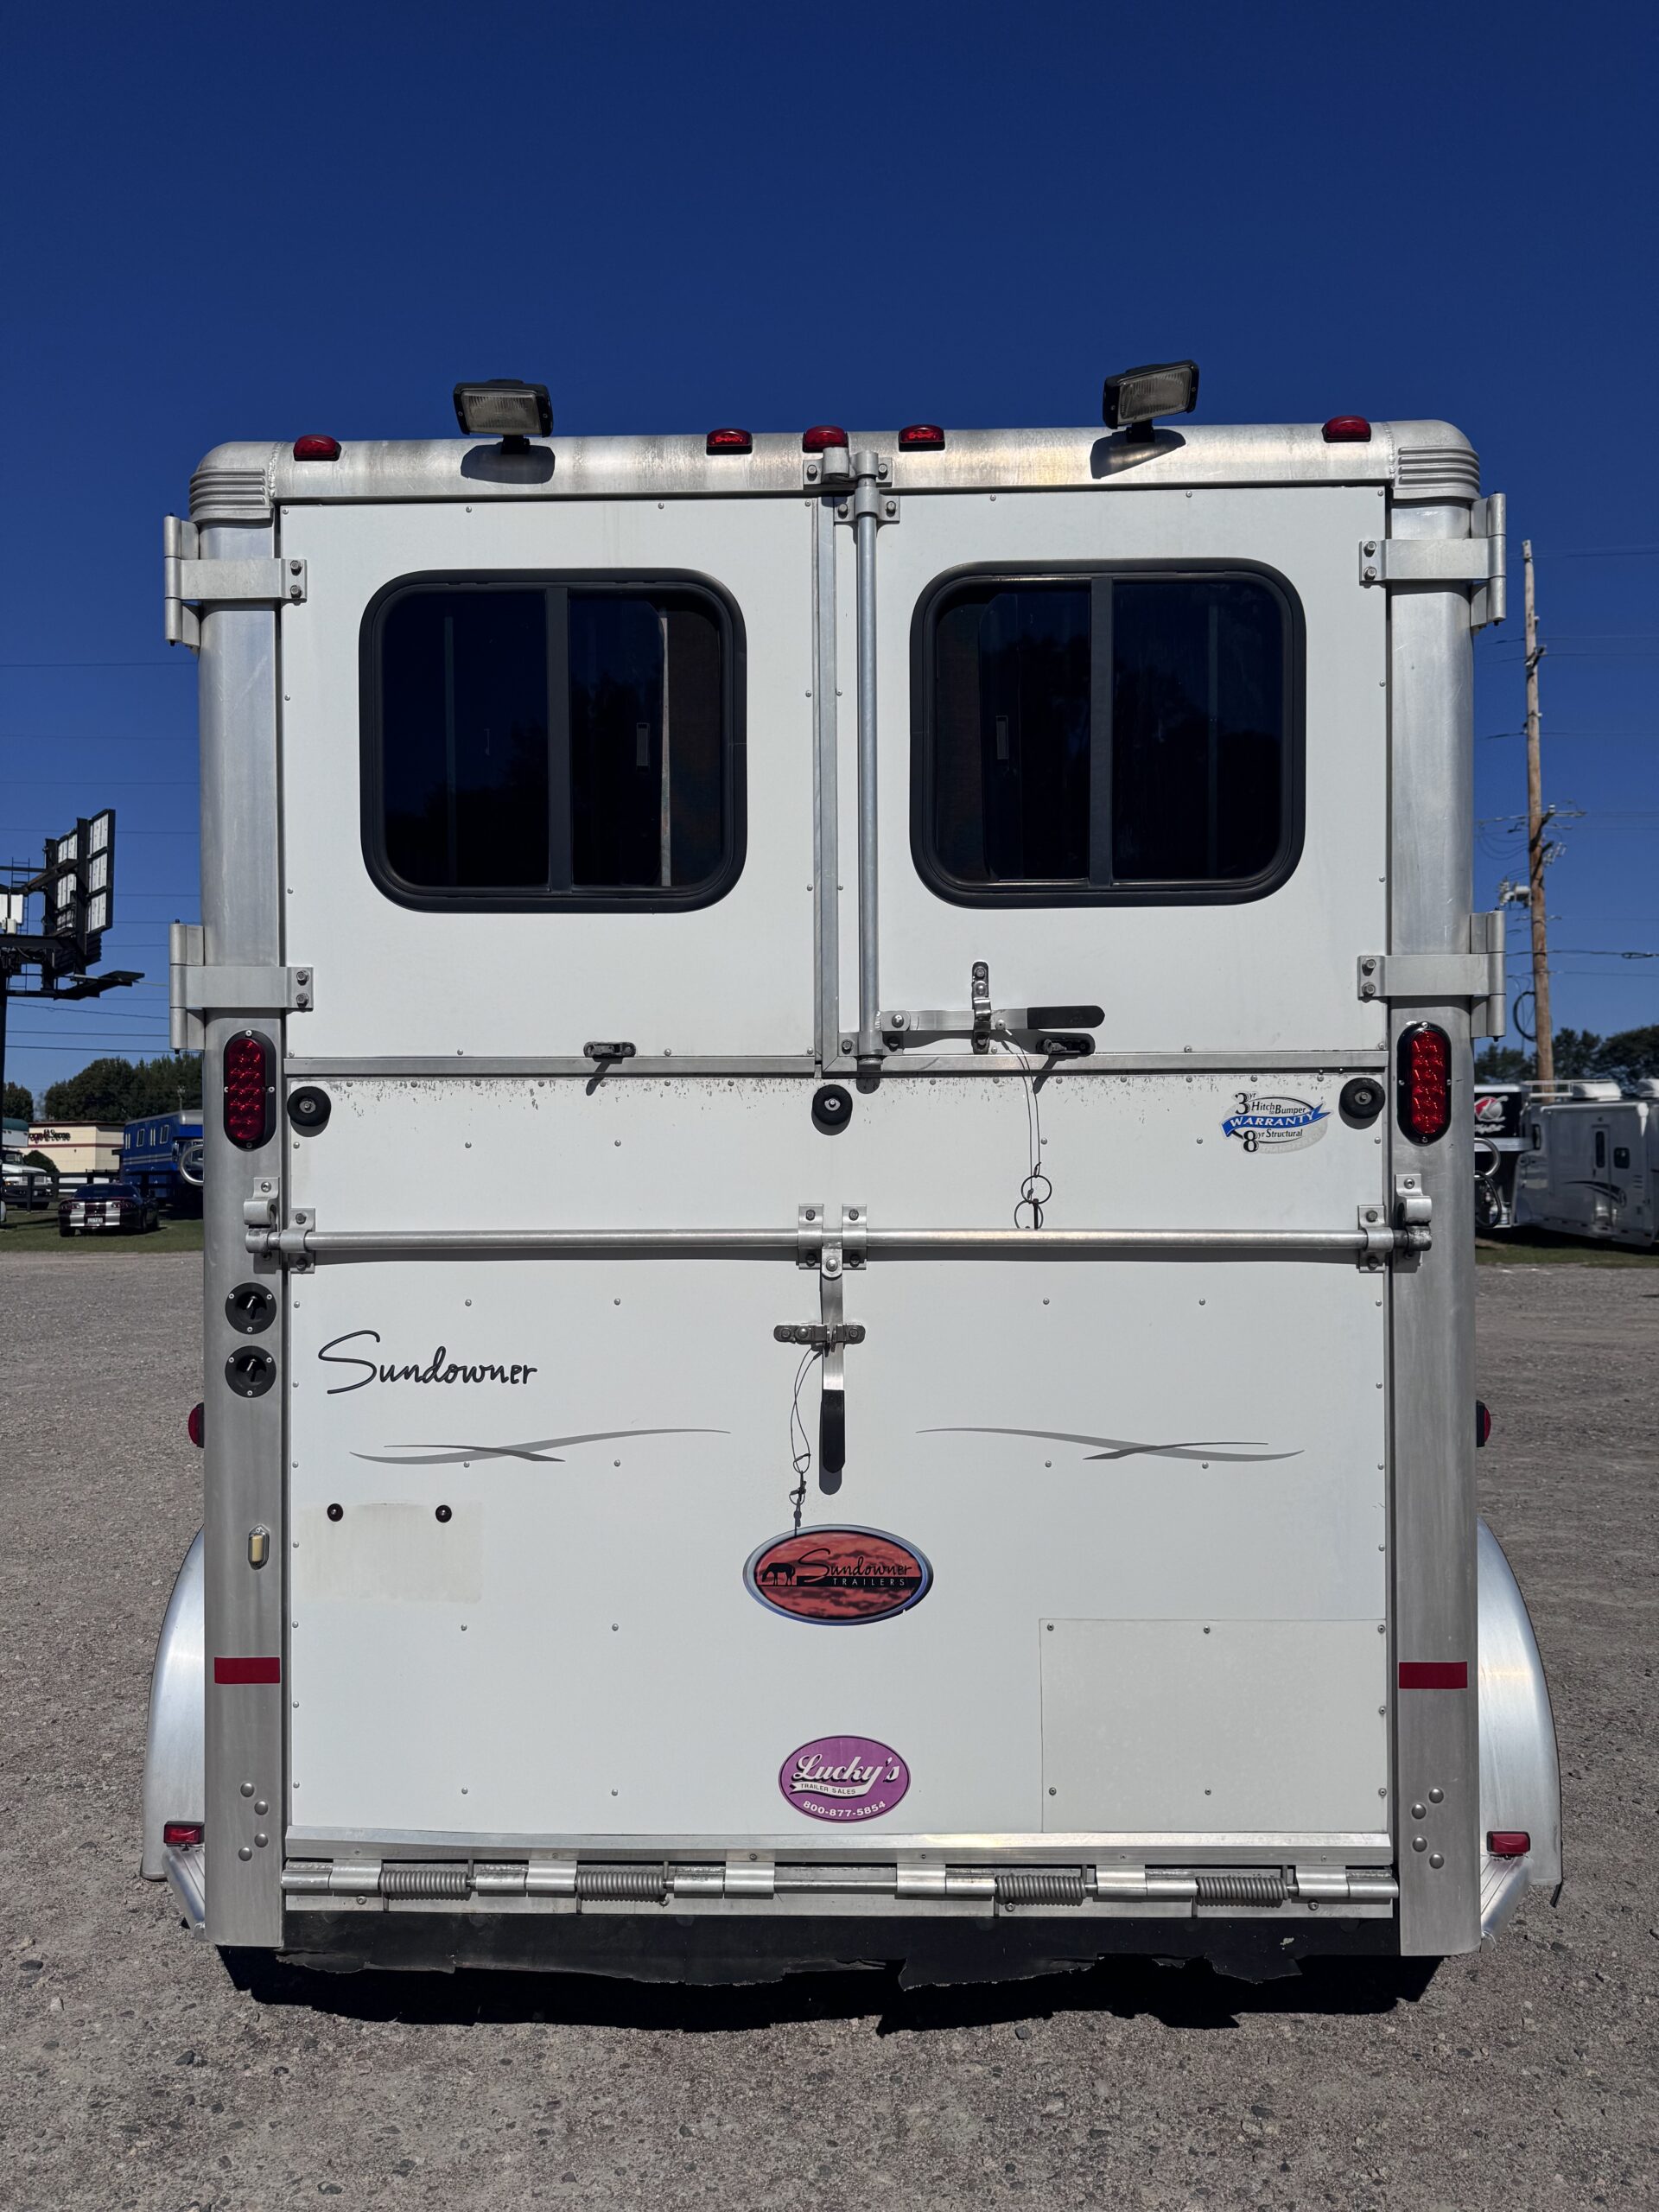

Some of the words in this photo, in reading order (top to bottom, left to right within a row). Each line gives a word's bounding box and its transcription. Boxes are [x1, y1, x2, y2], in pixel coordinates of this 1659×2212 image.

[1251, 1102, 1275, 1111] Hitch
[1274, 1105, 1306, 1116] Bumper
[1230, 1111, 1314, 1128] WARRANTY
[1243, 1130, 1258, 1153] 8
[1266, 1128, 1303, 1138] Structural
[318, 1330, 538, 1395] Sundowner
[798, 1548, 912, 1583] Sundowner
[833, 1578, 906, 1586] TRAILERS
[791, 1753, 900, 1789] Lucky's
[800, 1783, 829, 1793] TRAILER
[803, 1800, 887, 1817] 800-877-5854
